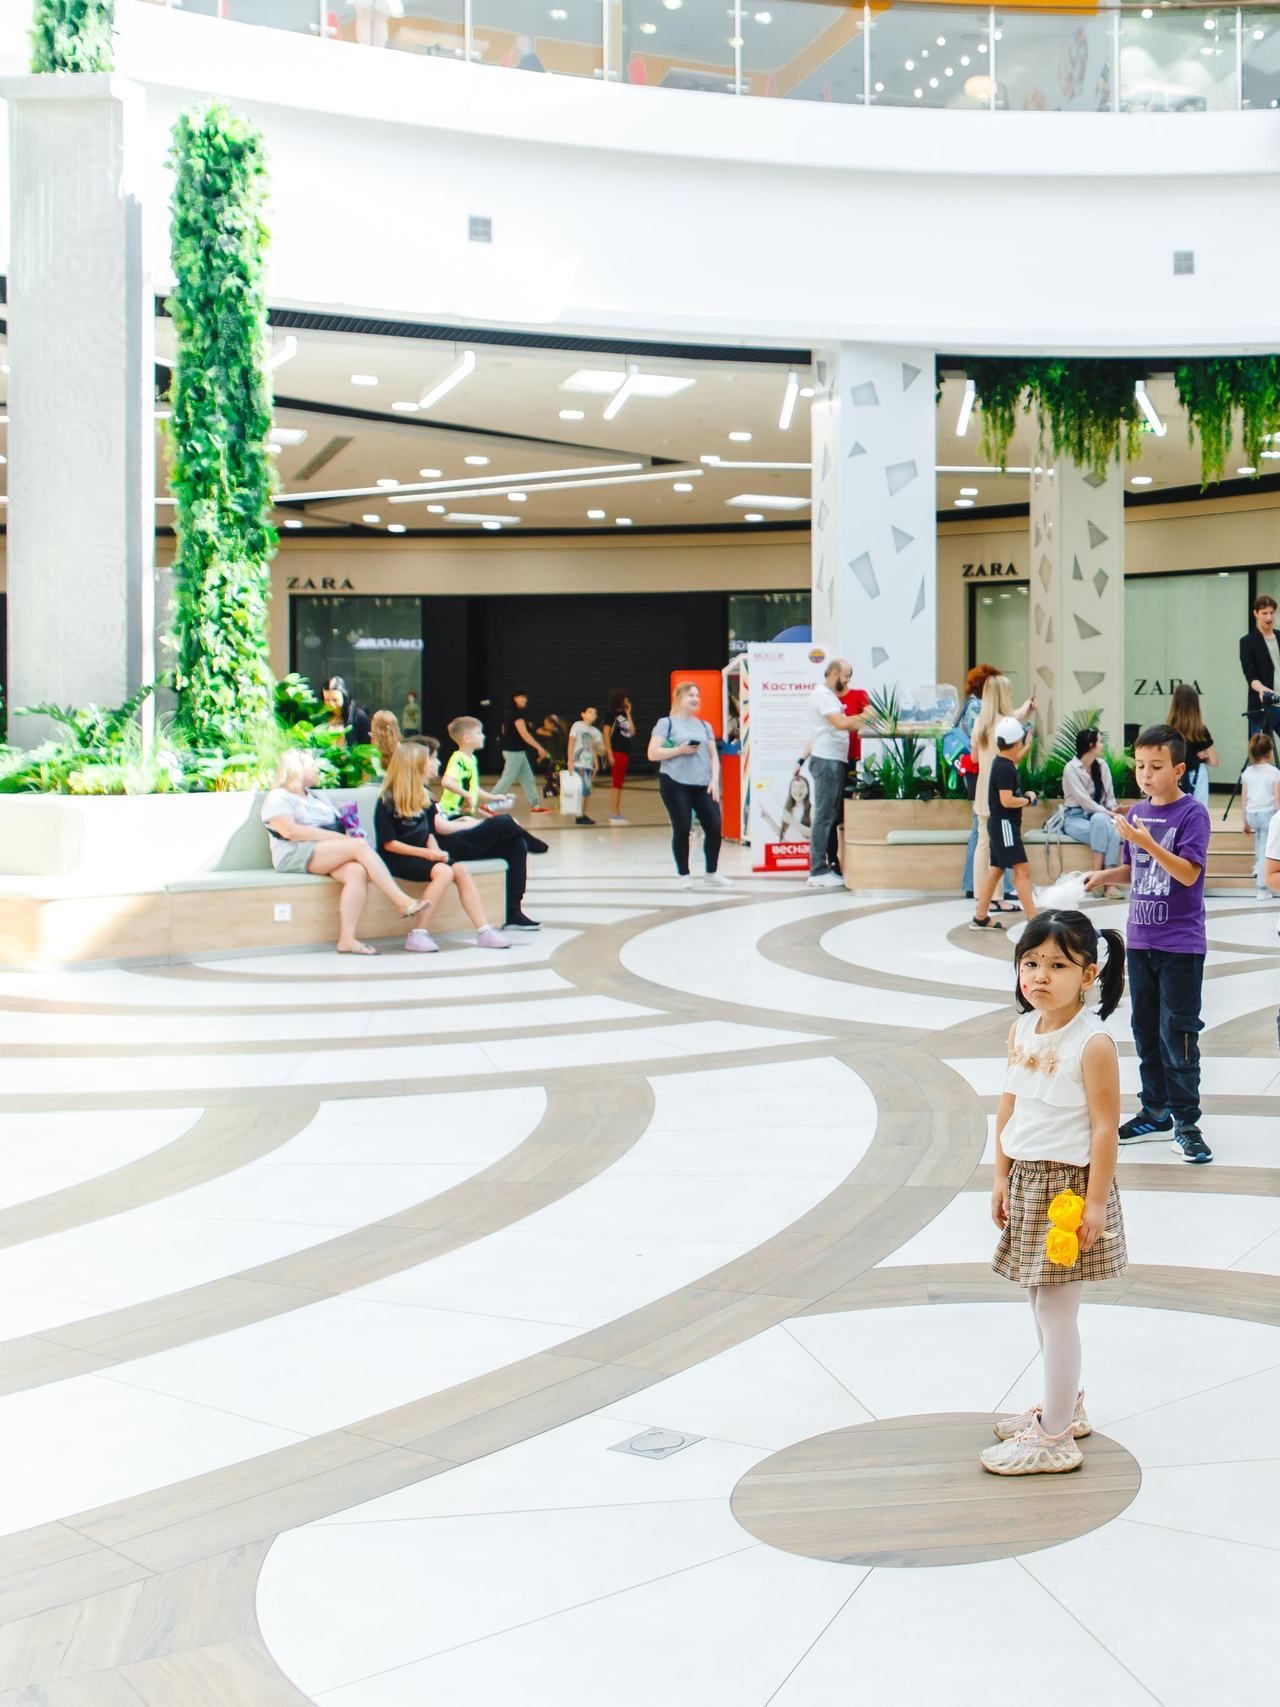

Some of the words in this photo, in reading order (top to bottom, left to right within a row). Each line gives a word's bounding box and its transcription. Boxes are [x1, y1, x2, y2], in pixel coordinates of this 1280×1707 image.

[962, 562, 1018, 577] ZARA
[286, 576, 355, 590] ZARA
[762, 682, 817, 690] Кастинг
